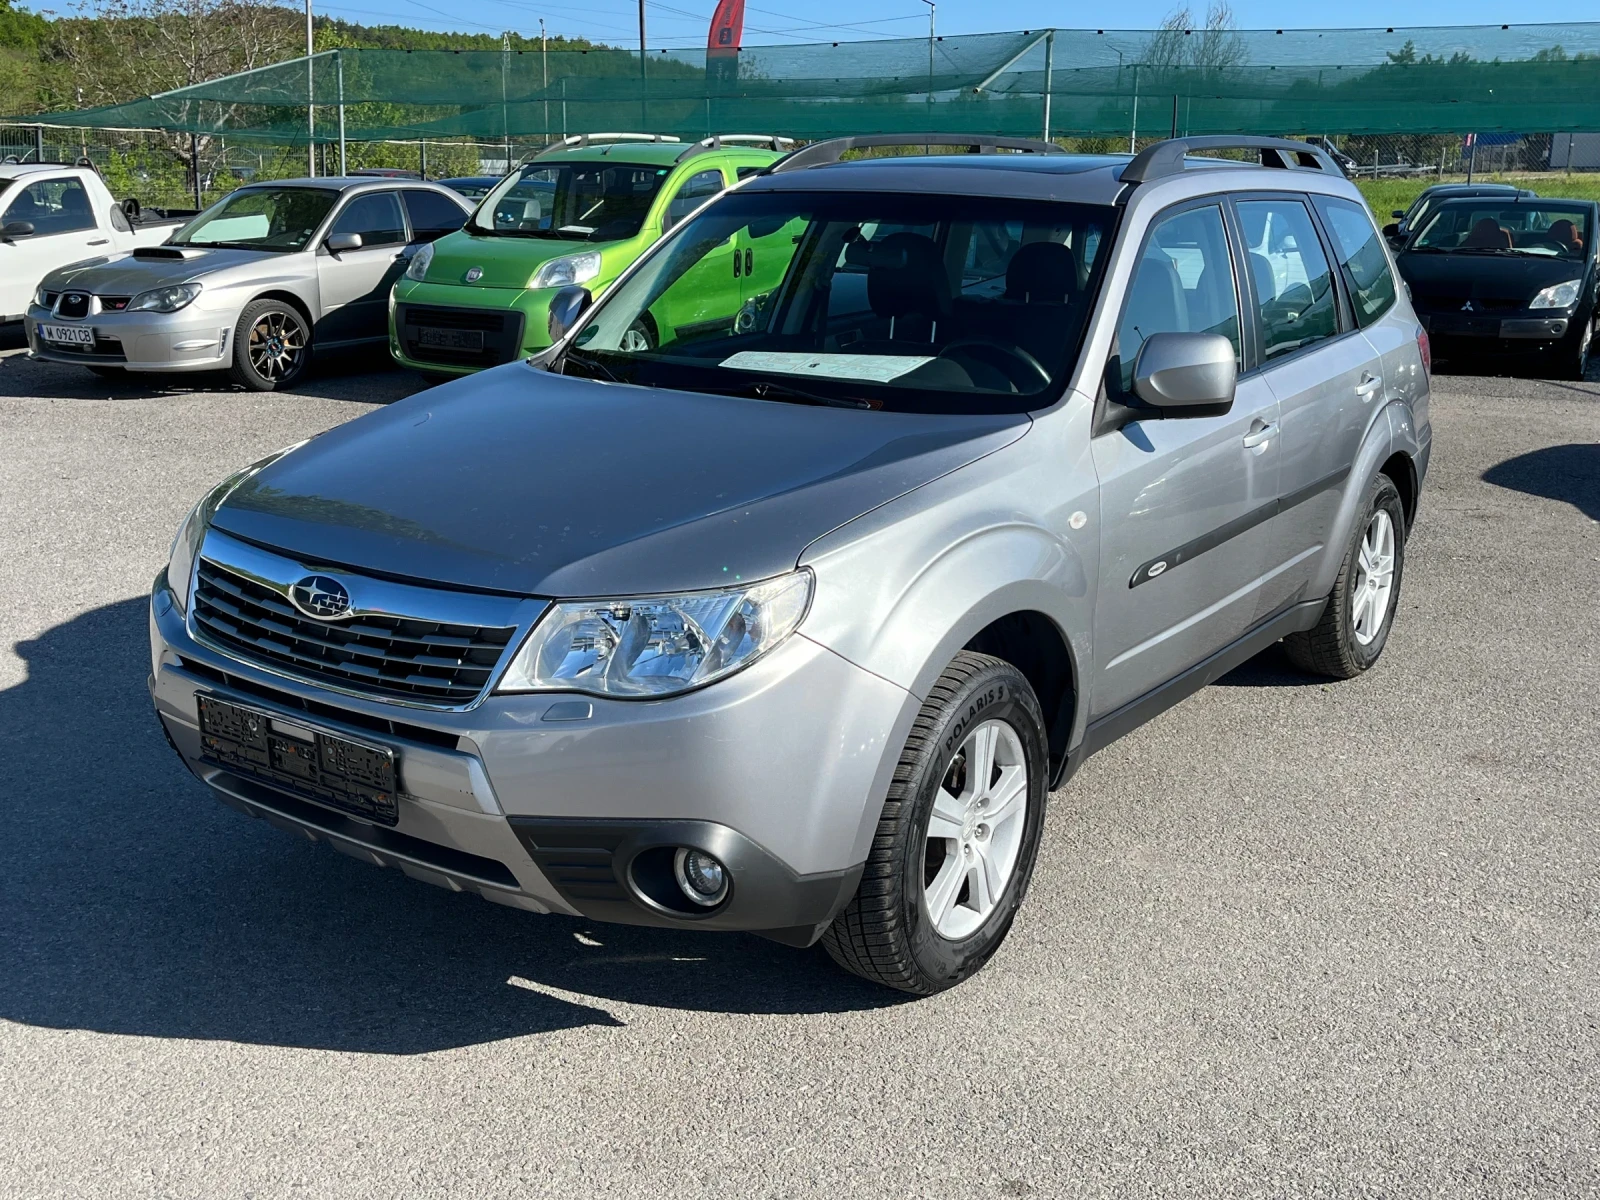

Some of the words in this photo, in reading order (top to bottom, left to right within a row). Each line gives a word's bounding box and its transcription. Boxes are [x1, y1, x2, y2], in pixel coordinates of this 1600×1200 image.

[46, 327, 54, 339] M
[56, 327, 78, 341] 0921
[78, 330, 91, 342] CB
[945, 689, 995, 751] POLARIS
